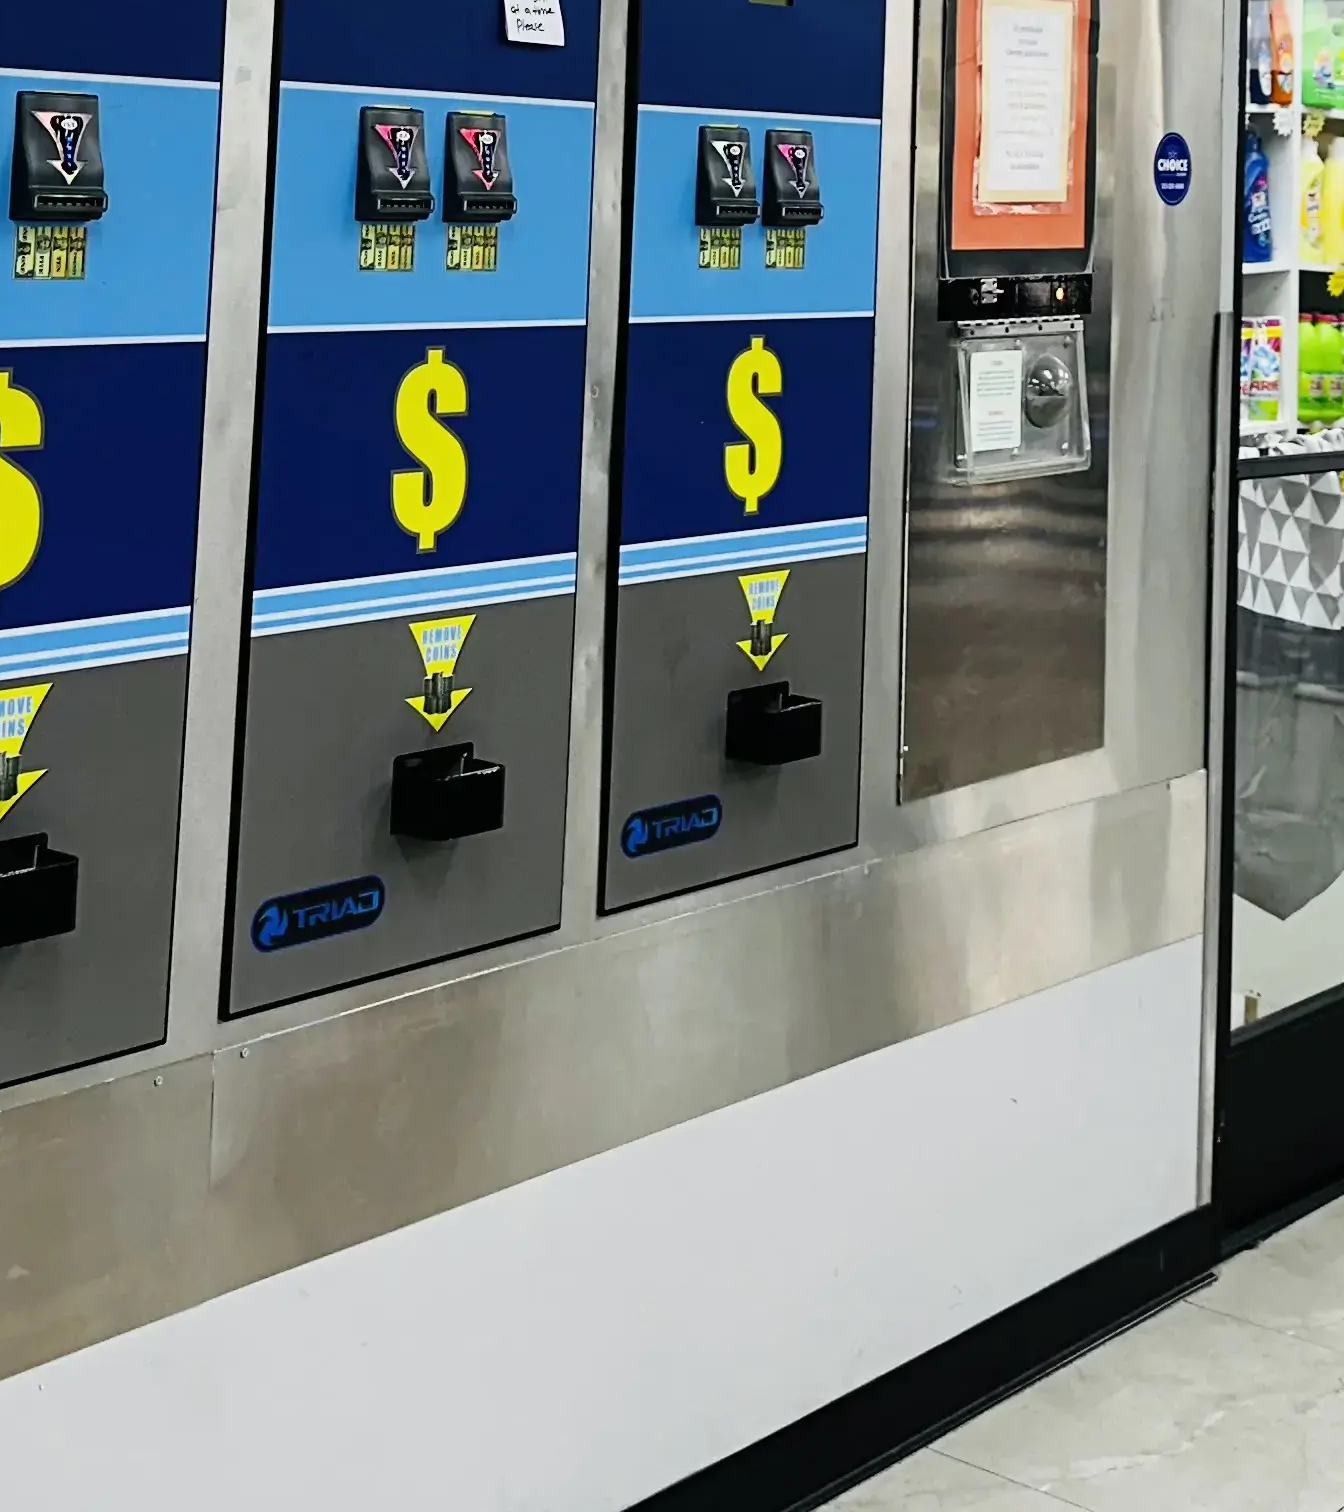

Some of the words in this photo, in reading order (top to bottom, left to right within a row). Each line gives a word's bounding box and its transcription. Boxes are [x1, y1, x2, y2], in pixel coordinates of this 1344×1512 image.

[517, 19, 544, 33] Please
[1158, 159, 1188, 171] CHOICE
[653, 807, 718, 838] TRIAD
[293, 890, 379, 928] TRIAD
